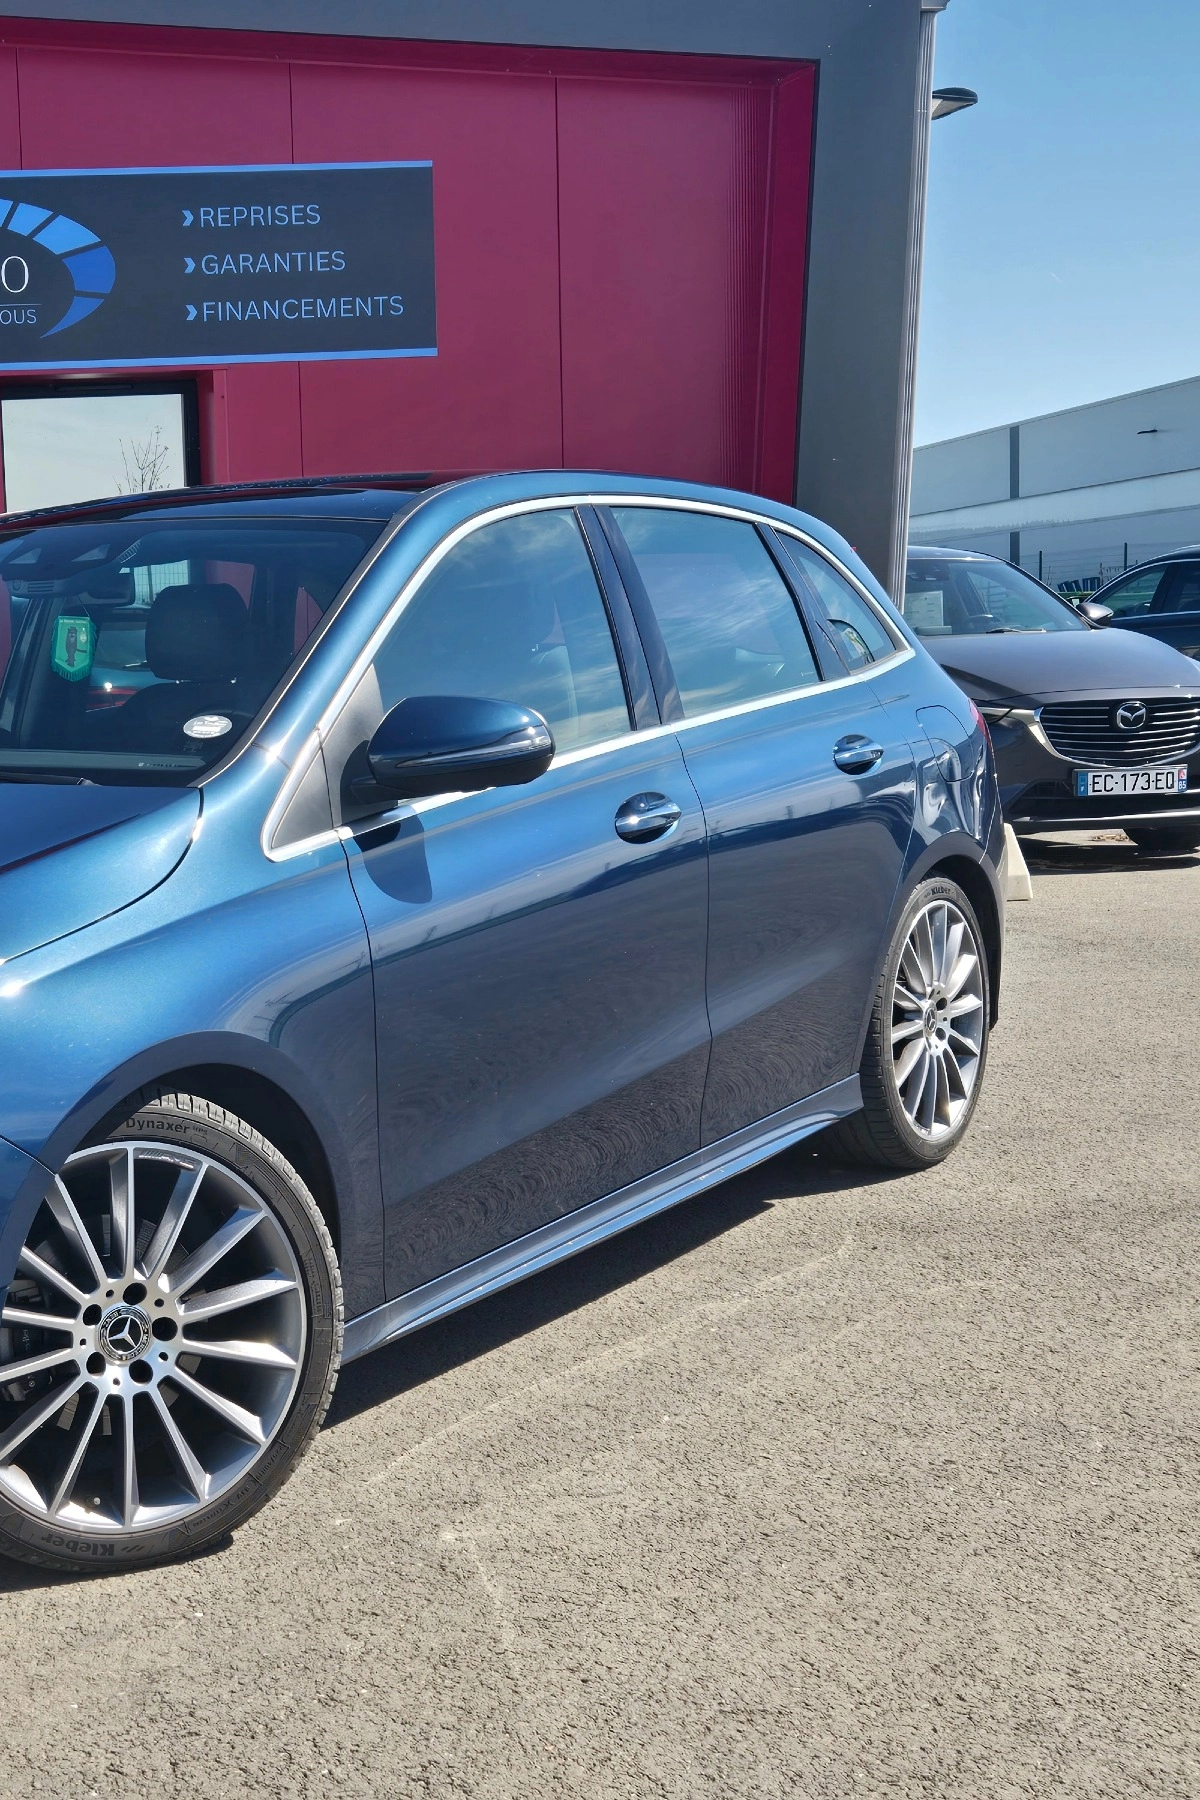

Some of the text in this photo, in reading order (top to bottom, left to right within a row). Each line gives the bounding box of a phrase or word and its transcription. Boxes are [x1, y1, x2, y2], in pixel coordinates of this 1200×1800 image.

[200, 204, 321, 227] REPRISES
[201, 250, 346, 275] GARANTIES
[202, 295, 404, 322] FINANCEMENTS
[126, 1118, 190, 1134] Dynaxer
[40, 1534, 115, 1557] Kleber
